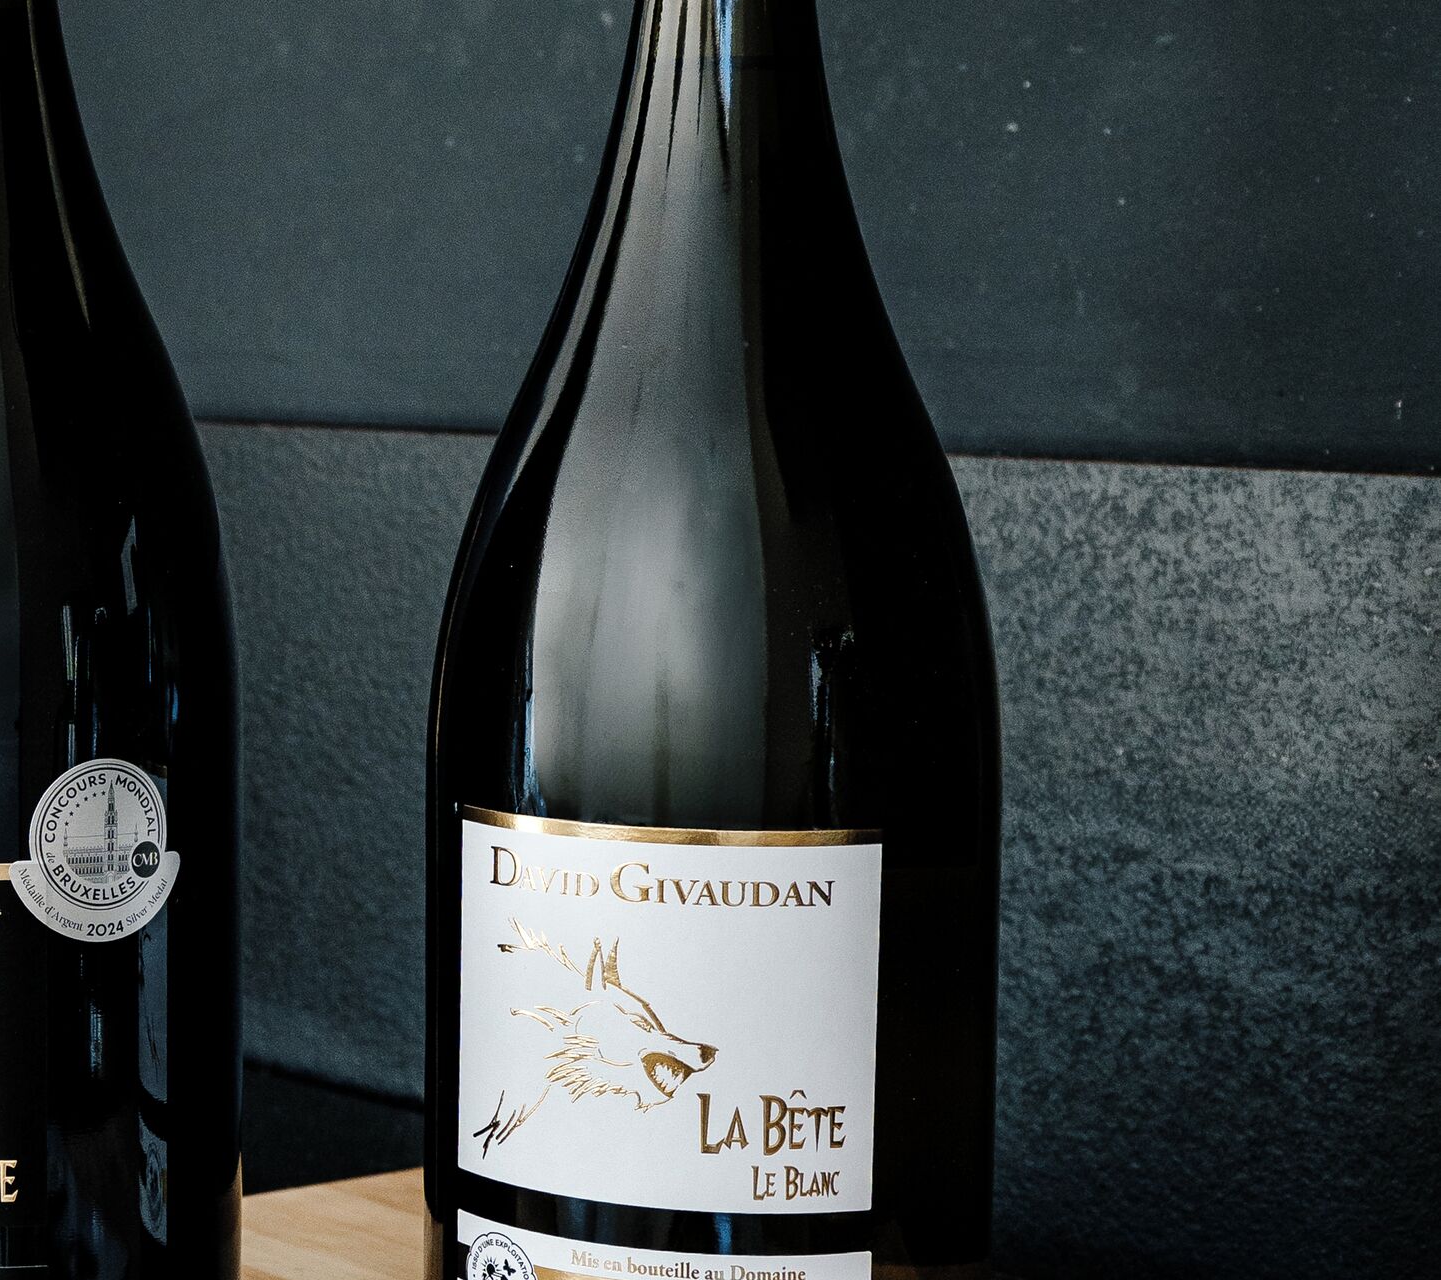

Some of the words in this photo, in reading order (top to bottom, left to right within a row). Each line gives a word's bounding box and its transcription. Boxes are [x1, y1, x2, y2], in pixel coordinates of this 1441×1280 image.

[45, 773, 107, 843] CONCOURS
[115, 774, 156, 836] MONDIAL
[46, 851, 55, 864] de
[52, 865, 136, 901] BRUXELLES
[132, 852, 158, 868] CMB
[489, 845, 600, 897] DAVID
[609, 861, 836, 908] GIVAUDAN
[19, 868, 46, 908] Médaille
[44, 906, 83, 932] d'Argent
[87, 920, 124, 937] 2024
[125, 906, 149, 926] Silver
[147, 878, 168, 907] Medal
[696, 1092, 750, 1154] LA
[759, 1089, 847, 1156] BÊTE
[751, 1165, 777, 1201] LE
[783, 1165, 840, 1201] BLANC
[571, 1249, 599, 1269] Mis
[603, 1259, 622, 1272] en
[627, 1257, 700, 1280] bouteille
[704, 1269, 724, 1280] au
